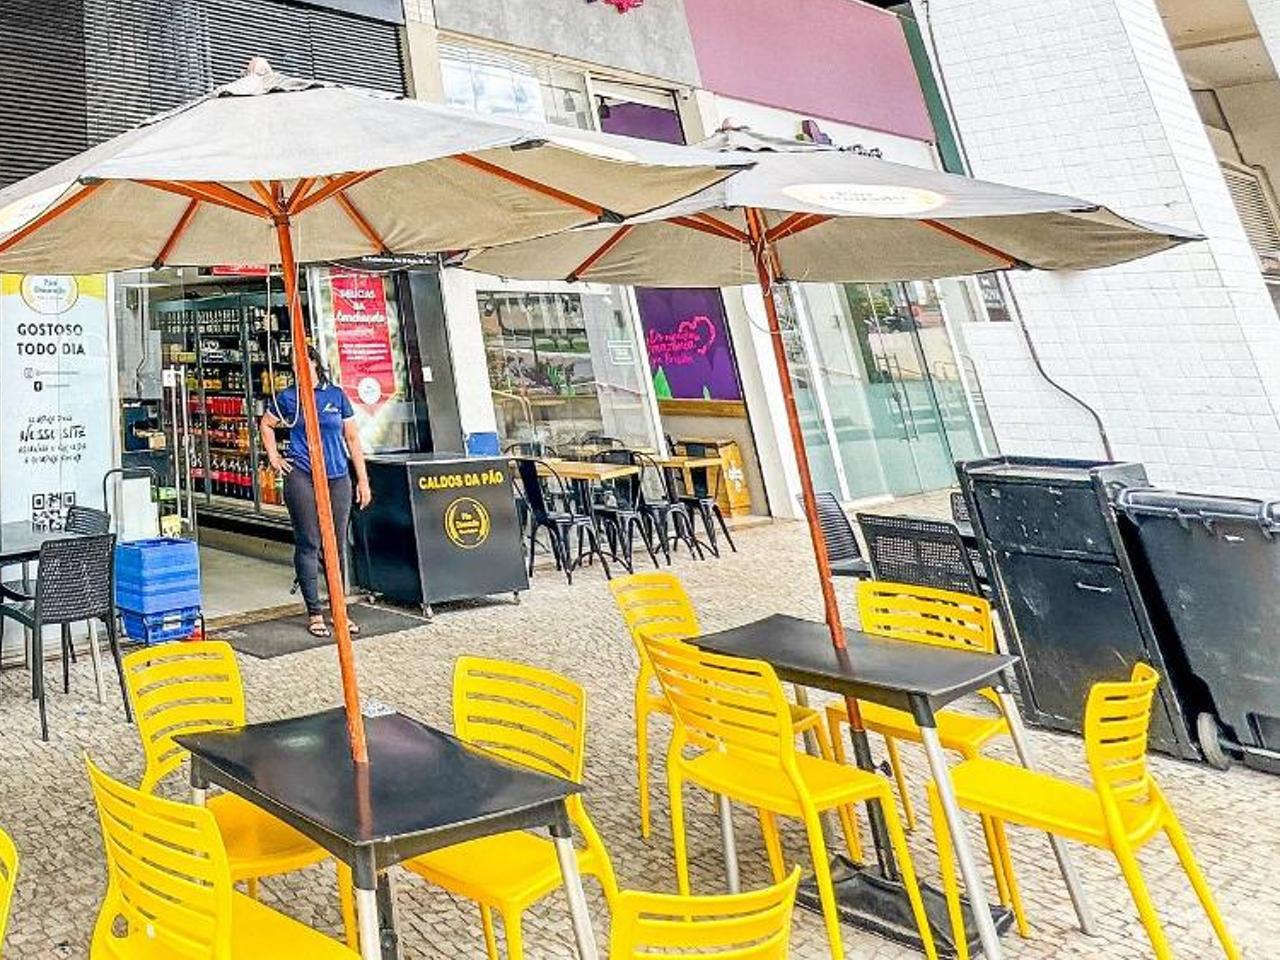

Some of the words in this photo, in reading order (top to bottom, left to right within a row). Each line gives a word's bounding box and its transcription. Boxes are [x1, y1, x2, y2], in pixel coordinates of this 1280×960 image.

[17, 323, 83, 337] GOSTOSO
[16, 343, 58, 356] TODO
[62, 343, 86, 356] DIA
[419, 474, 464, 490] CALDOS
[464, 473, 481, 487] DA
[481, 468, 504, 485] PÃO
